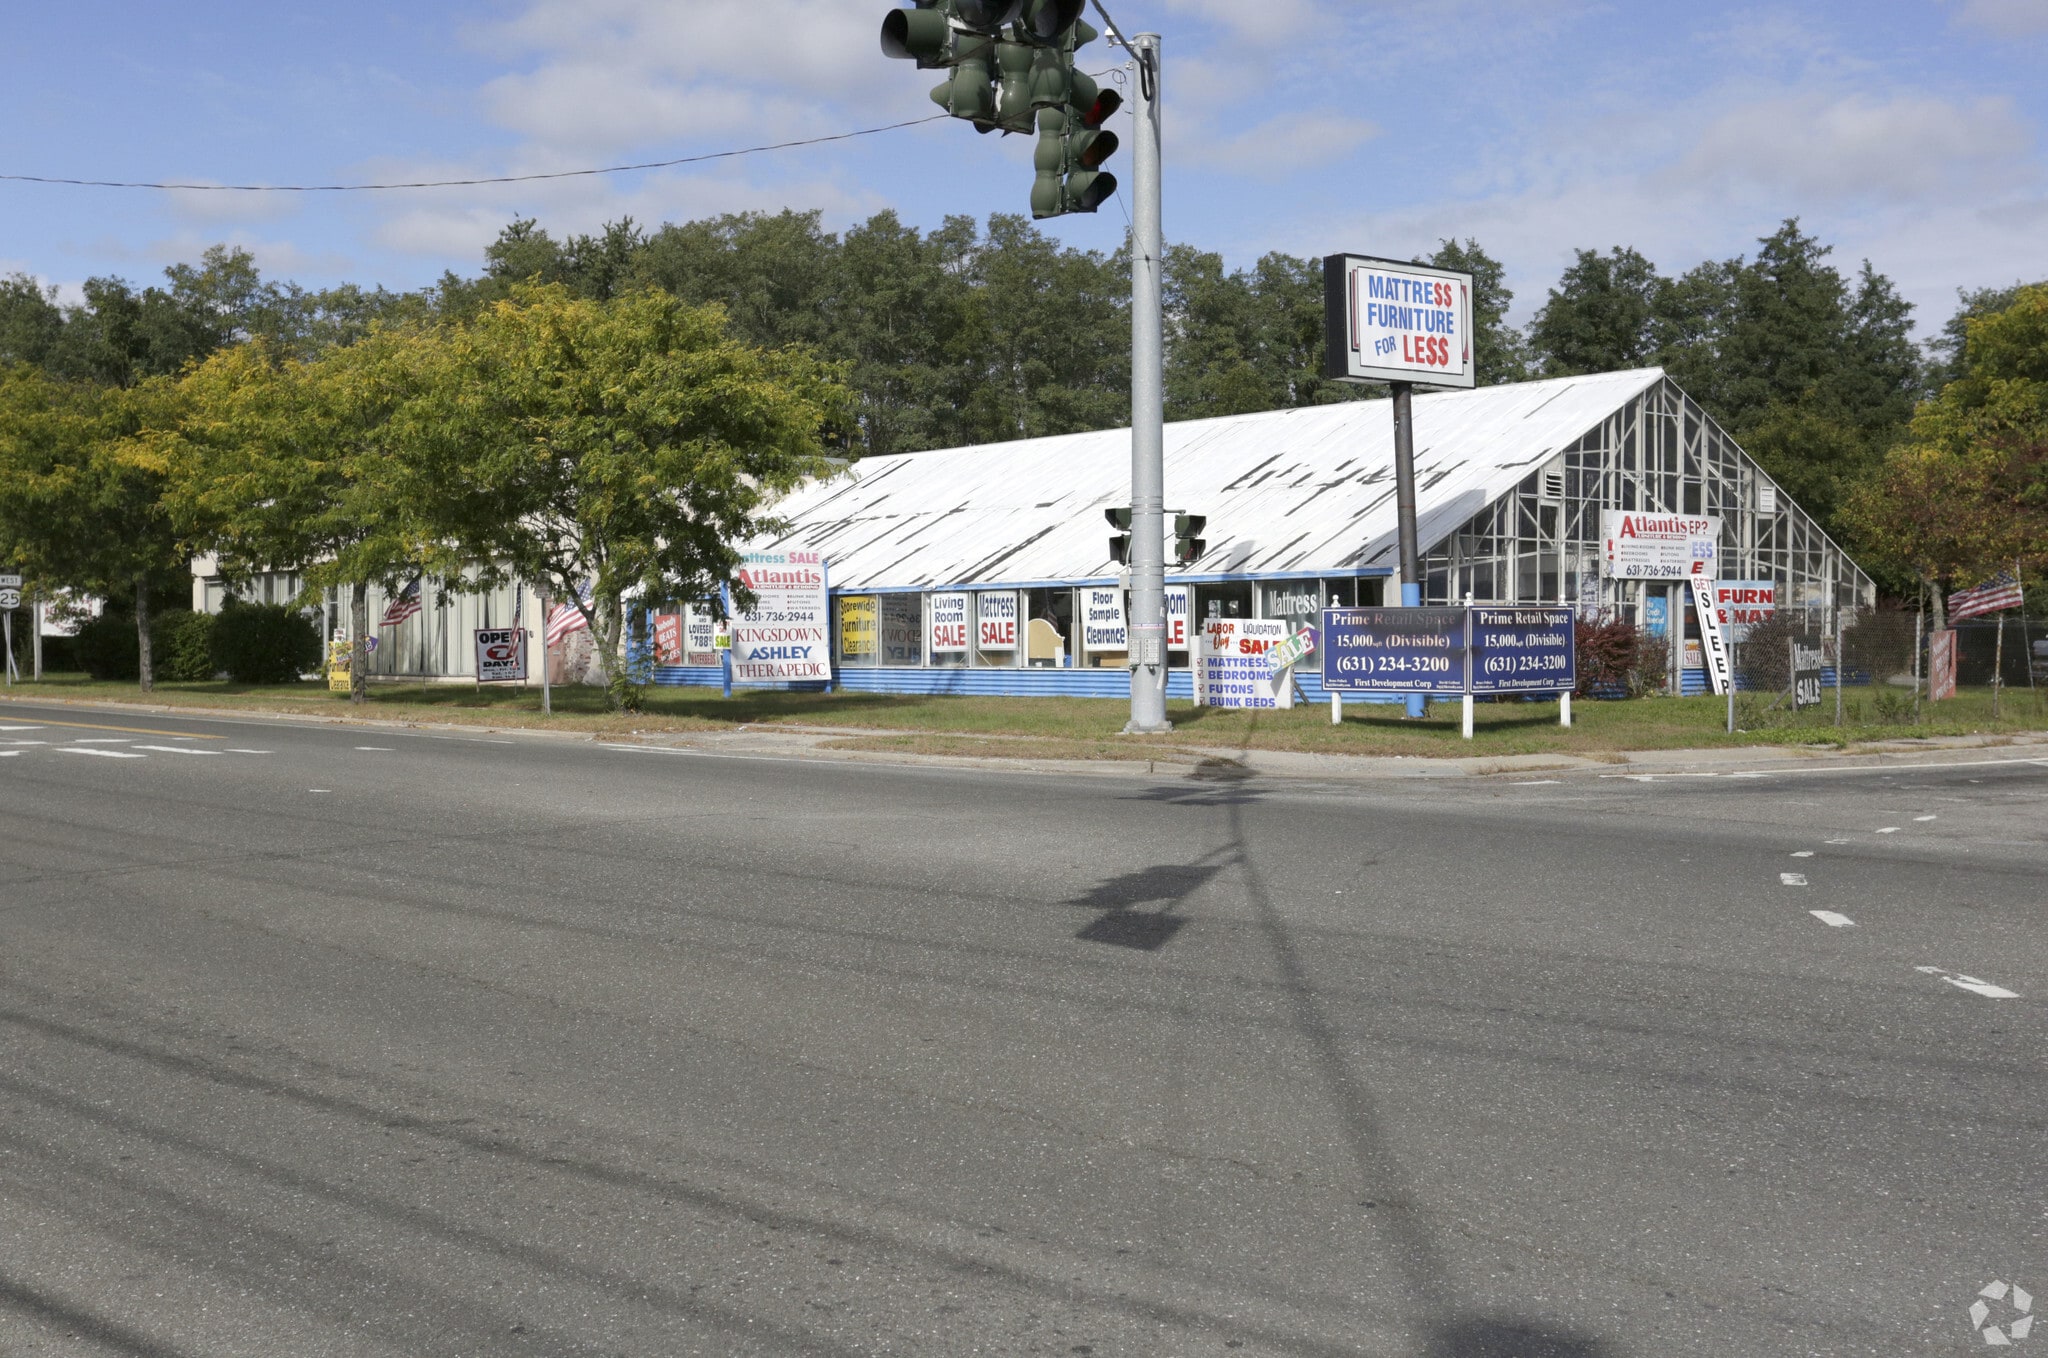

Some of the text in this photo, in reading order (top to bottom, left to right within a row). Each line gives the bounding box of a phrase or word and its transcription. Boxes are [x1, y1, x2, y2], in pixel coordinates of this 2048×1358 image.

[1368, 303, 1454, 334] FURNITURE
[1375, 336, 1397, 356] FOR
[1620, 515, 1687, 538] Atlantis
[789, 551, 819, 564] SALE
[739, 568, 821, 589] Atlantis
[1693, 577, 1711, 591] GET
[0, 592, 19, 605] 25
[840, 597, 876, 614] Storewide
[934, 597, 964, 611] Living
[980, 595, 1014, 617] Mattress
[1092, 592, 1113, 604] Floor
[1269, 590, 1318, 617] Mattress
[934, 612, 963, 622] Room
[1089, 608, 1120, 622] Sample
[1332, 611, 1456, 628] Prime Retail Space
[1480, 612, 1569, 627] Prime Retail Space
[1717, 609, 1728, 624] &
[841, 617, 876, 633] Furniture
[1207, 623, 1281, 635] LABOR LIQUIDATION
[736, 627, 822, 643] KINGSDOWN
[934, 625, 966, 647] SALE
[982, 622, 1014, 645] SALE
[1086, 626, 1125, 645] Clearance
[1213, 633, 1230, 650] Day
[1385, 634, 1450, 649] (Divisible)
[1525, 633, 1566, 649] (Divisible)
[747, 645, 813, 660] ASHLEY
[843, 637, 876, 653] Clearance
[1266, 630, 1315, 671] SALE
[1336, 656, 1449, 673] (631) 234-3200
[1484, 655, 1566, 675] (631) 234-3200
[1685, 652, 1700, 664] SALE
[736, 662, 827, 678] THERAPEDIC
[1208, 670, 1274, 680] BEDROOMS
[1209, 684, 1254, 694] FUTONS
[1354, 678, 1371, 687] First
[1371, 679, 1413, 688] Development
[1414, 680, 1432, 689] Corp
[1498, 679, 1511, 687] First
[1512, 679, 1542, 688] Development
[1542, 678, 1555, 687] Corp
[1797, 678, 1821, 705] SALE
[1209, 697, 1276, 708] BUNK BEDS
